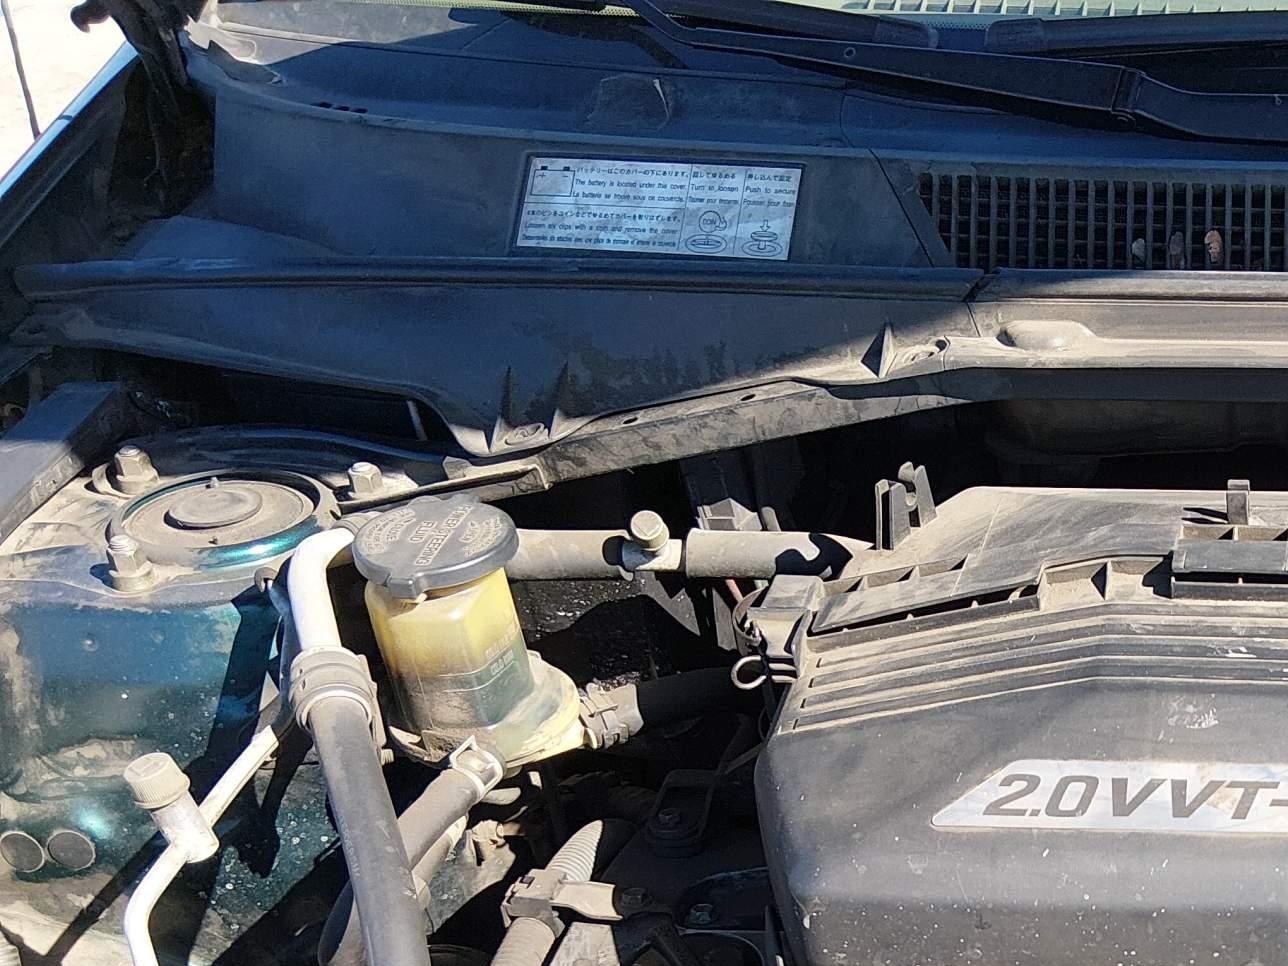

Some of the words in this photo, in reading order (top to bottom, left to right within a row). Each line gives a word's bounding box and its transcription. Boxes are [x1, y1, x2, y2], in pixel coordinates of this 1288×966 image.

[691, 183, 705, 191] Turn
[745, 185, 762, 193] Push
[443, 503, 474, 530] POWER
[409, 519, 438, 543] FLUID
[414, 527, 456, 566] STEERING
